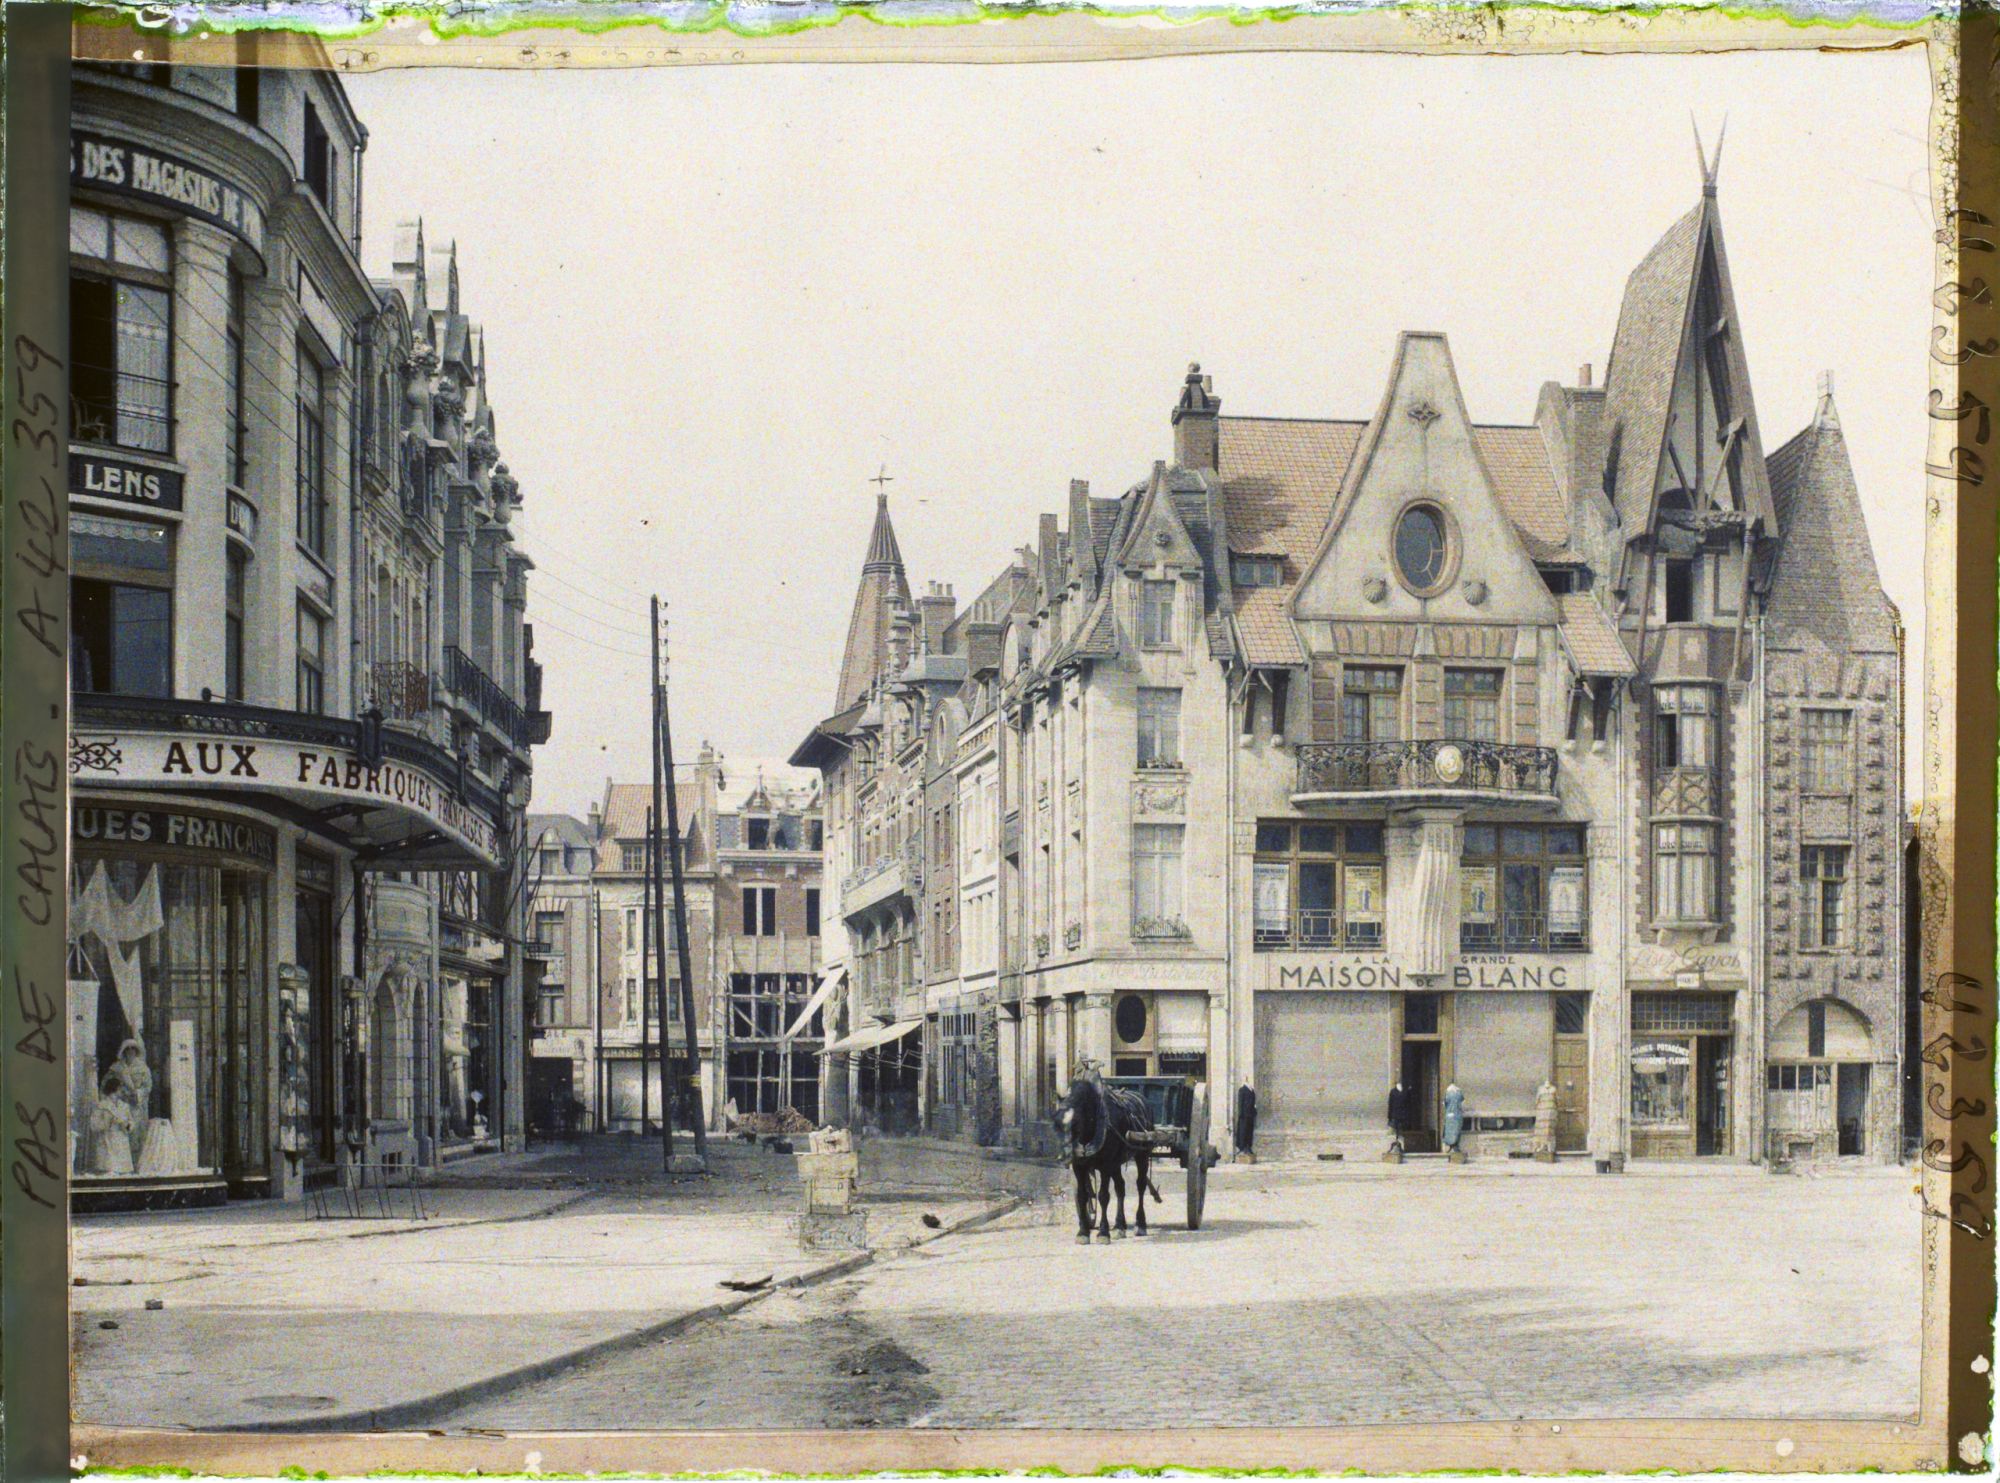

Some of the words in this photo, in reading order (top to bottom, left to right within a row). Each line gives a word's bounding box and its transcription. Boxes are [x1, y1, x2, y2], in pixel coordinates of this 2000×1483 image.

[82, 141, 126, 184] DES
[132, 152, 221, 217] MAGASINS
[84, 463, 161, 500] LENS
[162, 741, 259, 778] AUX
[298, 750, 432, 812] FABRIQUES
[1354, 956, 1362, 965] A
[1372, 956, 1390, 965] LA
[1460, 956, 1517, 965] GRANDE
[1416, 978, 1434, 988] DE
[1454, 966, 1567, 989] BLANC
[14, 964, 57, 1063] DE
[12, 1100, 57, 1209] PAS
